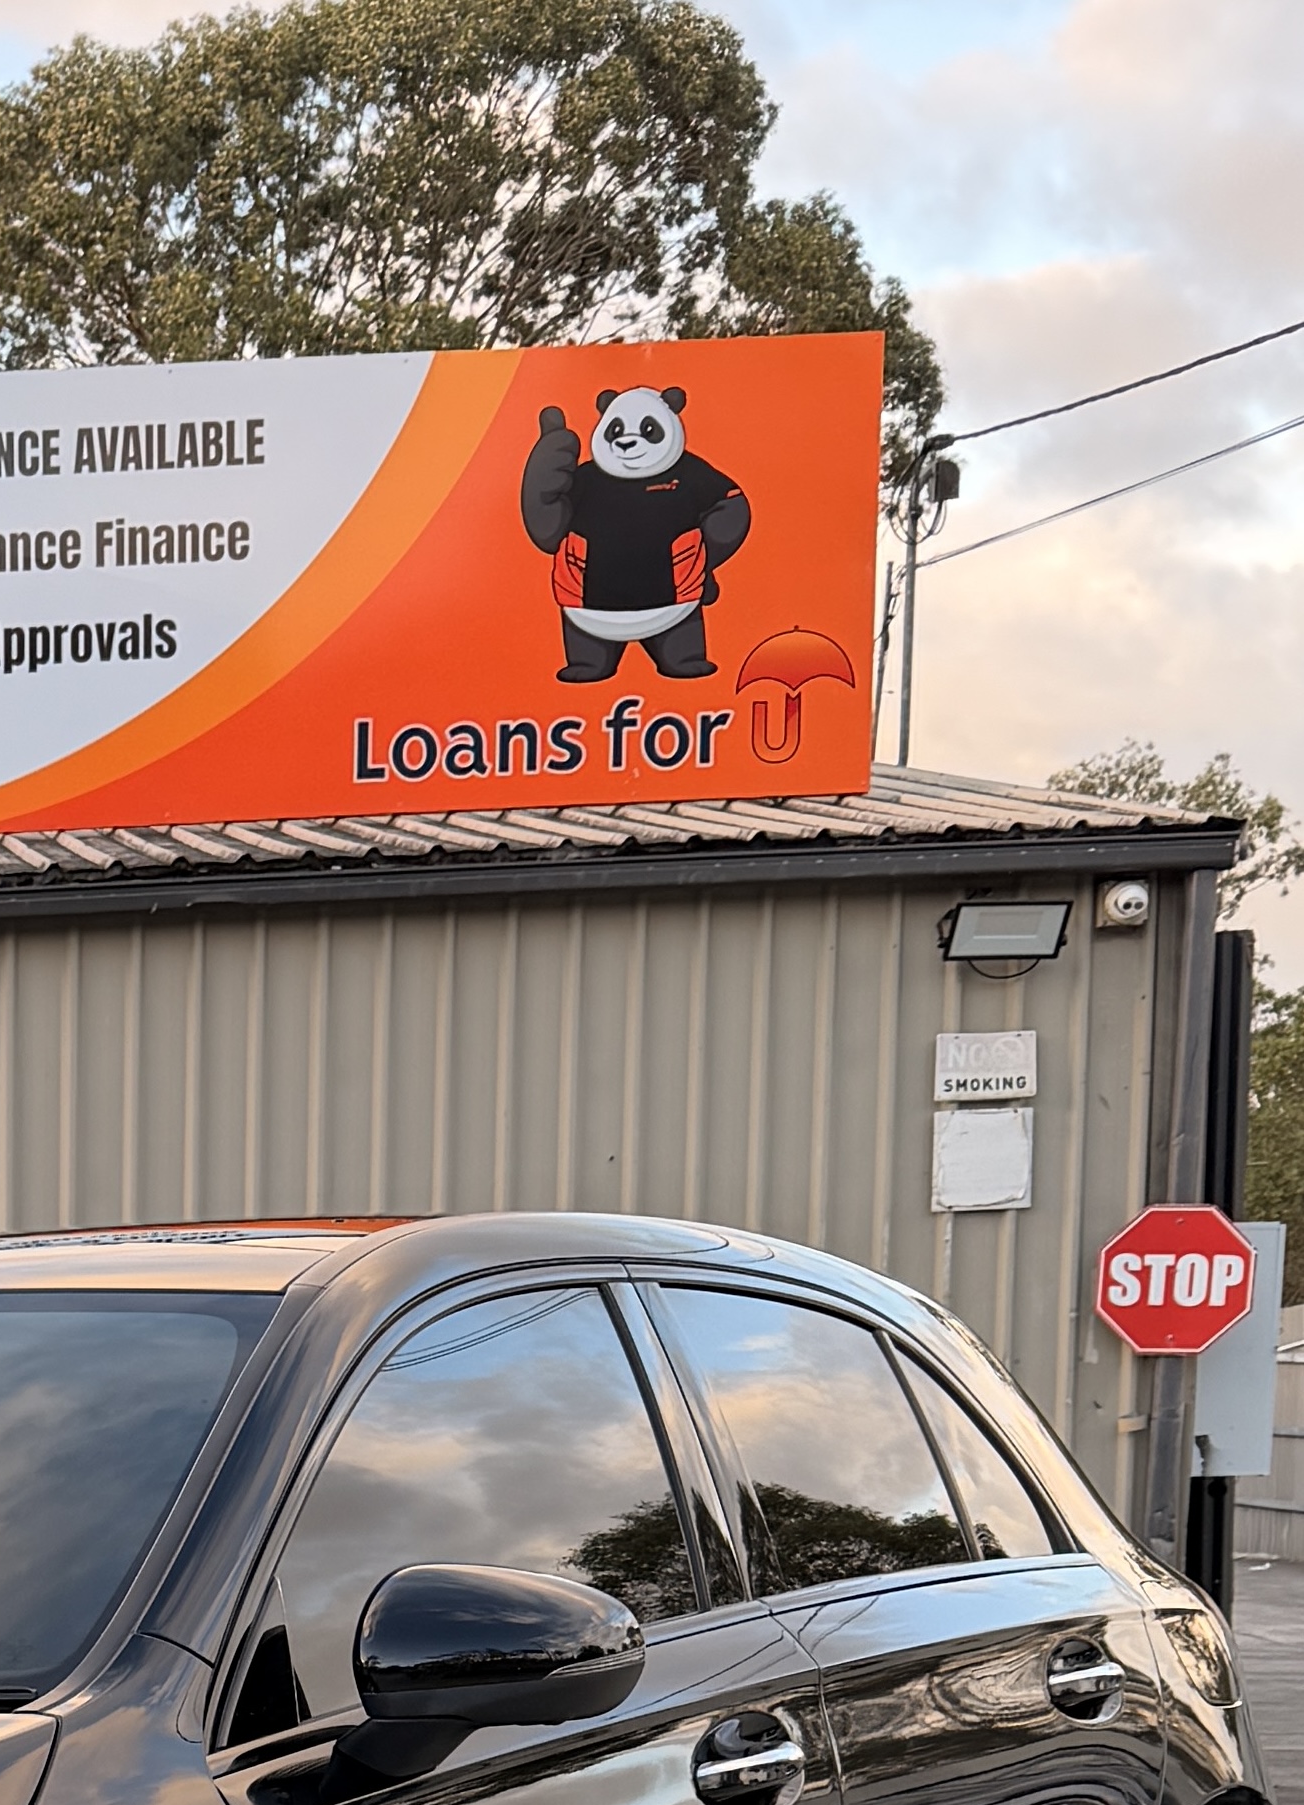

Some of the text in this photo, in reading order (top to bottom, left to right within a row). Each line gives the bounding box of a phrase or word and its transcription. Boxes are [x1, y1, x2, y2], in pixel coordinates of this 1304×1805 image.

[73, 418, 265, 474] AVAILABLE
[95, 518, 250, 568] Finance
[354, 717, 585, 782] Loans
[603, 697, 733, 770] for
[943, 1075, 1027, 1093] SMOKING
[1108, 1253, 1245, 1307] STOP
